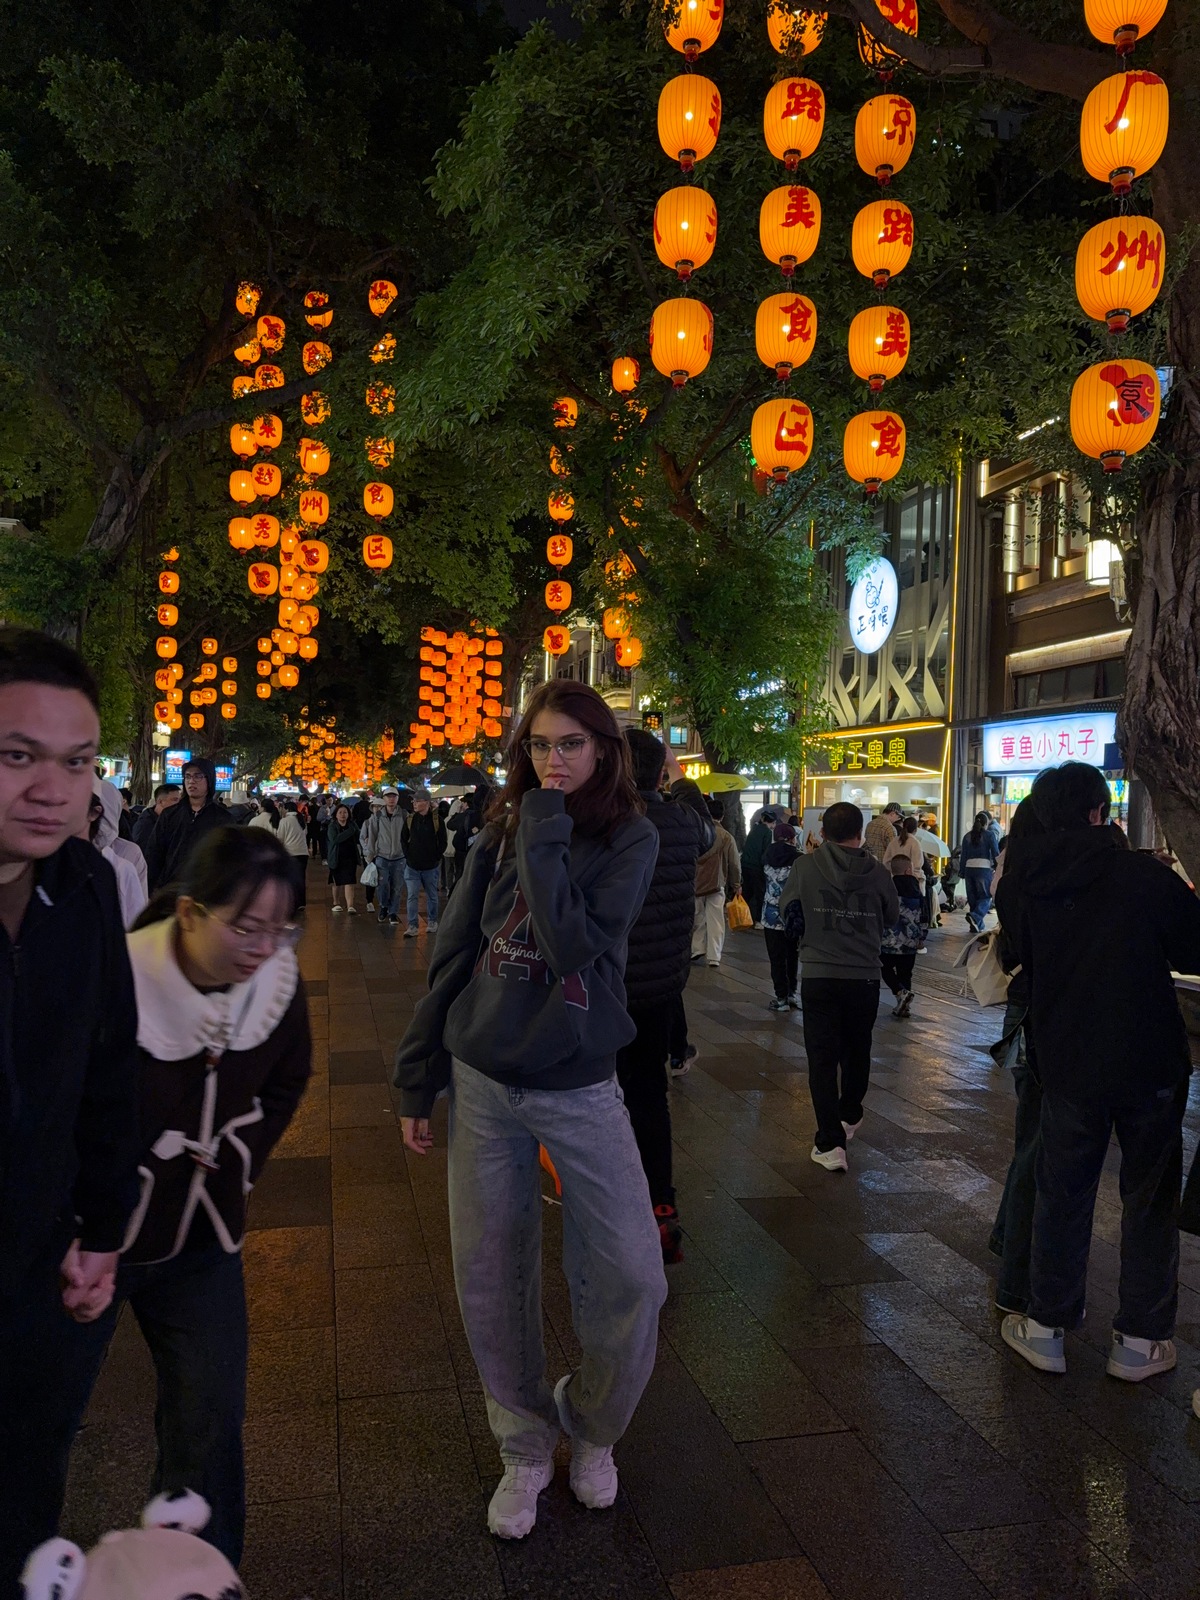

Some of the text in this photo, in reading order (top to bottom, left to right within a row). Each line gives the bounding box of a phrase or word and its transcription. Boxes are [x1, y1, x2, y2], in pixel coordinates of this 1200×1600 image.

[885, 98, 914, 145] 京
[780, 186, 816, 229] 美
[1100, 229, 1162, 289] 州
[779, 297, 813, 343] 食
[876, 311, 908, 358] 美
[774, 404, 810, 456] 区
[870, 415, 903, 459] 食
[1001, 728, 1096, 760] 章鱼小丸子
